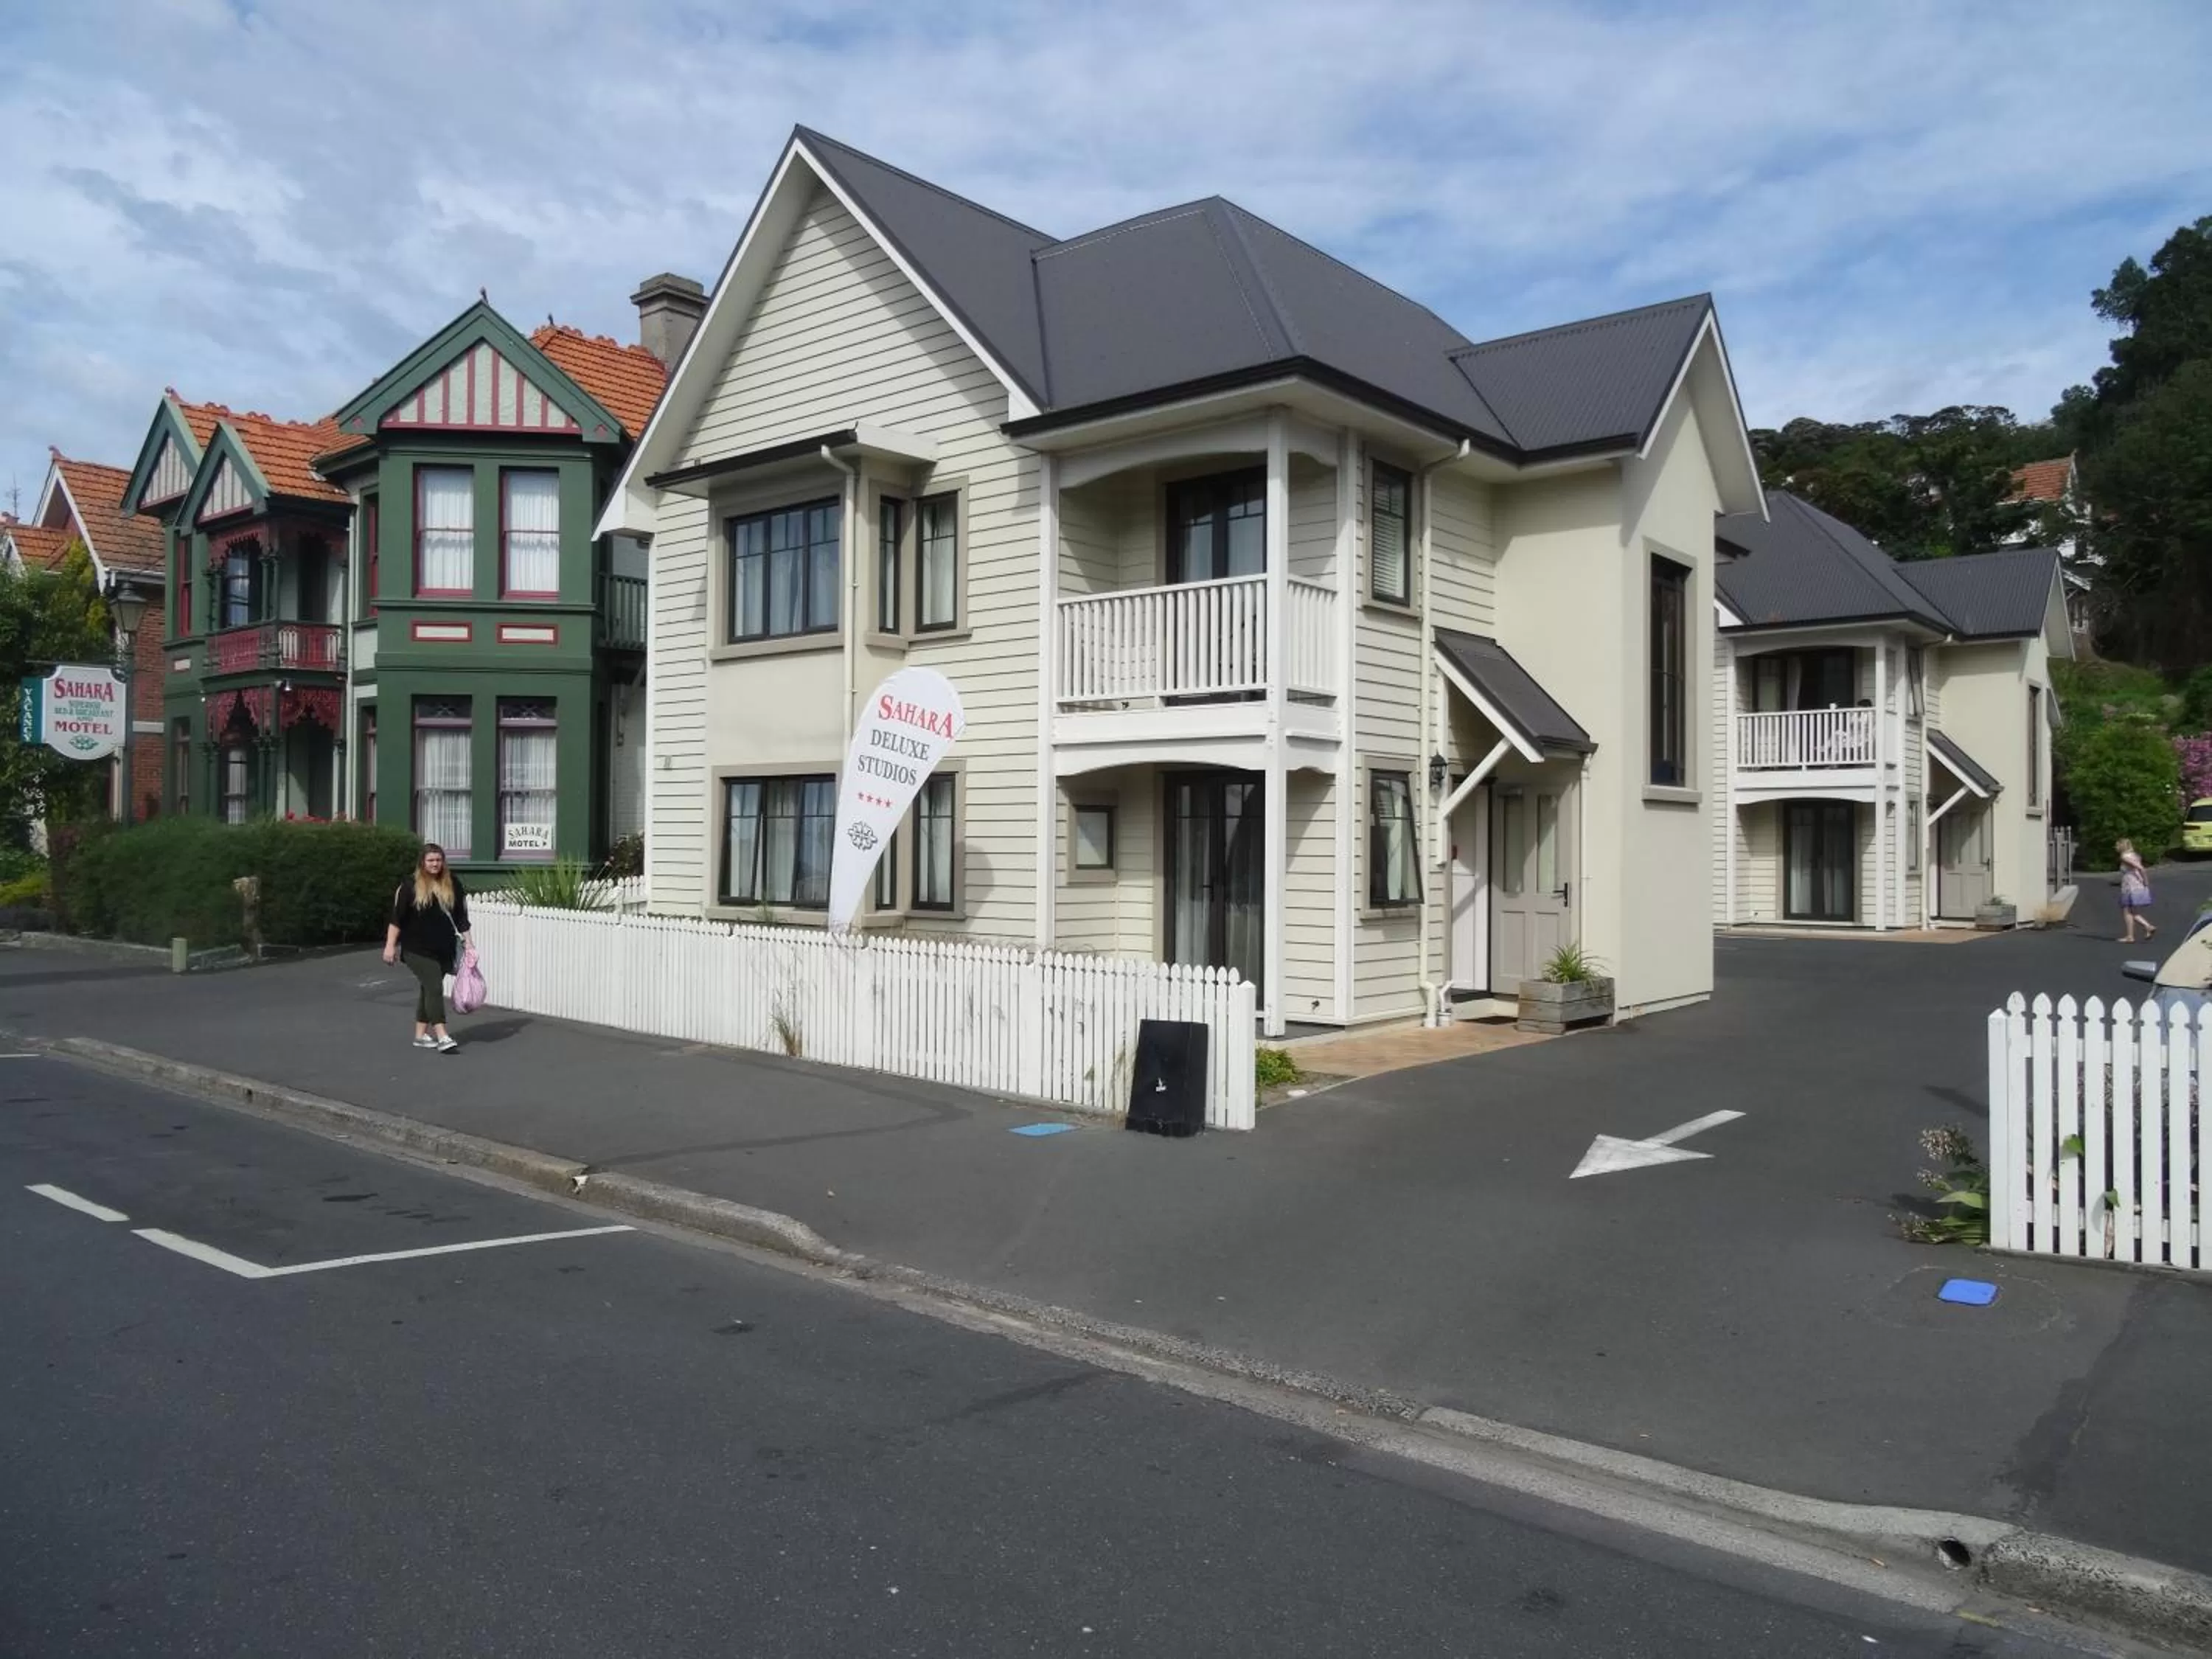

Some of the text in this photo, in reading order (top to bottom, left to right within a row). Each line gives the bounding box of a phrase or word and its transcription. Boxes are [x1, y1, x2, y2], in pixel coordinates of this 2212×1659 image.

[54, 678, 114, 702] SAHARA
[23, 688, 33, 742] VACANCY
[54, 720, 113, 734] MOTEL
[877, 694, 955, 738] SAHARA
[869, 728, 930, 762] DELUXE
[857, 754, 917, 786] STUDIOS
[508, 826, 549, 839] SAHARA
